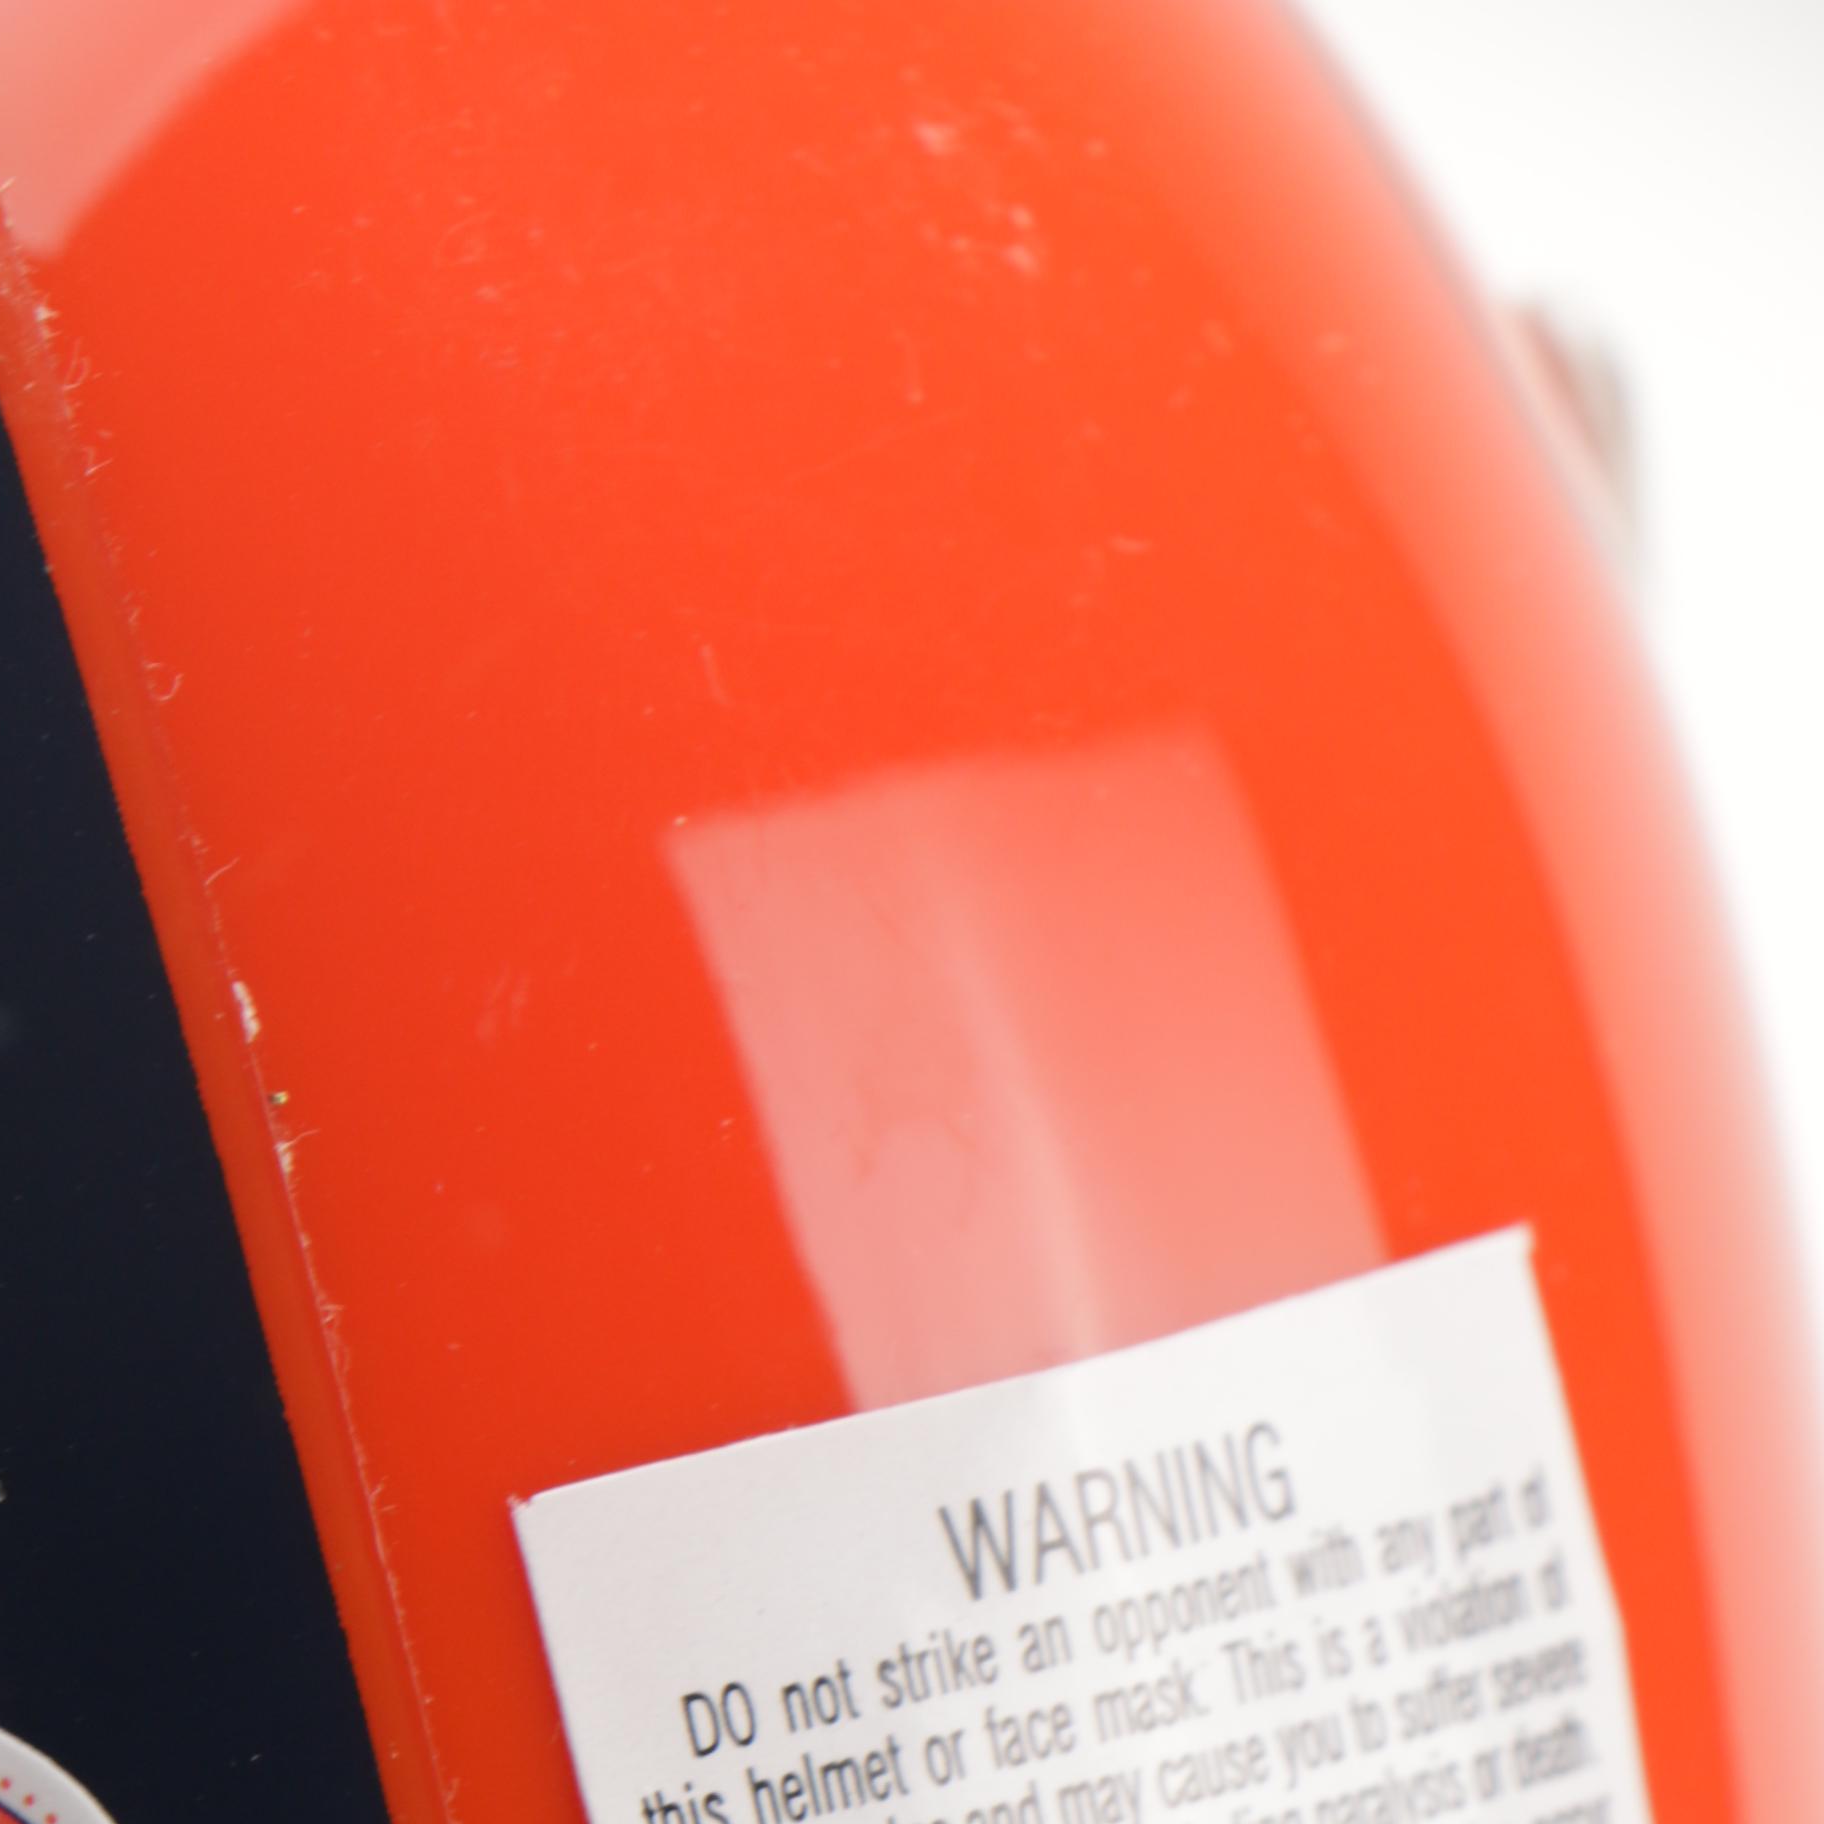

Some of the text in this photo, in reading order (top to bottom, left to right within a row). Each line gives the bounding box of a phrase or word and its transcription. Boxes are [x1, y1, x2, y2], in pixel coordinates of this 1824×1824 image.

[938, 1420, 1296, 1601] WARNING
[681, 1681, 758, 1759] DO
[782, 1658, 861, 1734] not
[876, 1628, 999, 1711] strike
[1016, 1614, 1073, 1673] an
[1093, 1551, 1276, 1661] opponent
[1286, 1524, 1365, 1599] with
[1376, 1514, 1436, 1577] any
[1448, 1481, 1514, 1565] part
[924, 1728, 966, 1786] or
[984, 1702, 1076, 1770] face
[1221, 1629, 1306, 1704] This
[1313, 1613, 1351, 1680] is
[1363, 1615, 1388, 1668] a
[1396, 1568, 1530, 1652] violation
[1158, 1733, 1271, 1808] cause
[1276, 1713, 1347, 1792] you
[1348, 1694, 1386, 1754] to
[1394, 1662, 1485, 1741] suffer
[1473, 1745, 1504, 1800] or
